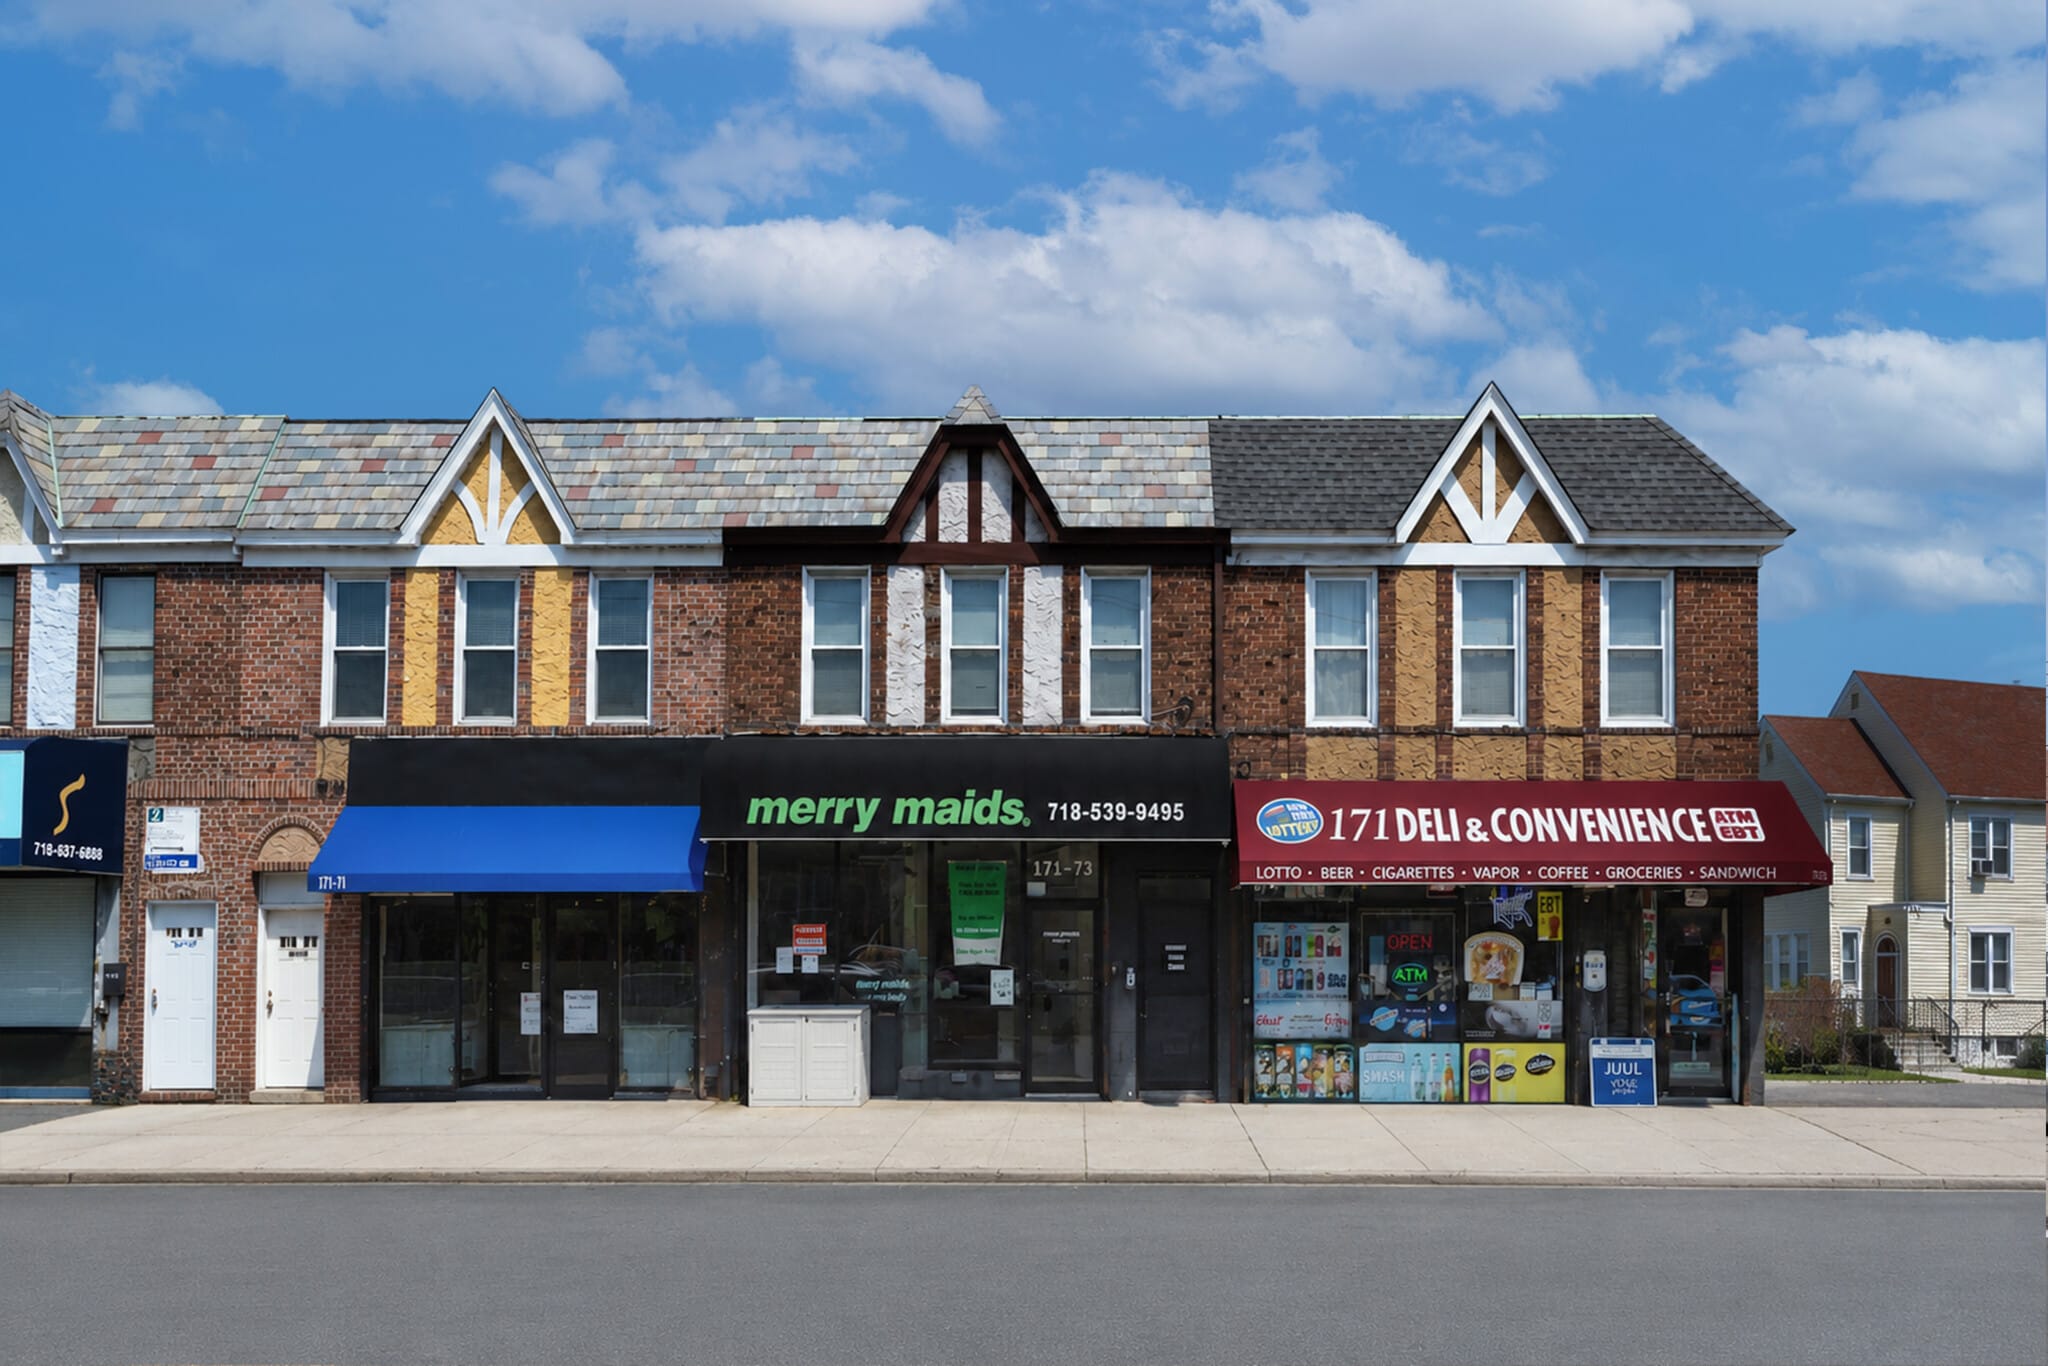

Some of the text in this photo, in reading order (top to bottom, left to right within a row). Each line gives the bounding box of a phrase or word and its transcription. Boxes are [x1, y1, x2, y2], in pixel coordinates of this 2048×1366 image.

[746, 797, 881, 833] merry
[1047, 802, 1185, 821] 718-539-9495
[1714, 810, 1755, 824] ATM
[1329, 807, 1712, 843] 171 DELI & CONVENIENCE
[1720, 826, 1759, 839] EBT
[1033, 860, 1093, 876] 171-73
[1256, 866, 1777, 880] LOTTO BEER CIGARETTES VAPOR COFFEE GROCERIES SANDWICH
[318, 875, 346, 890] 171-71
[1540, 896, 1560, 914] EBT
[1386, 933, 1433, 950] OPEN
[1395, 967, 1428, 983] ATM
[1363, 1070, 1405, 1083] SMASH
[1604, 1062, 1643, 1076] JUUL
